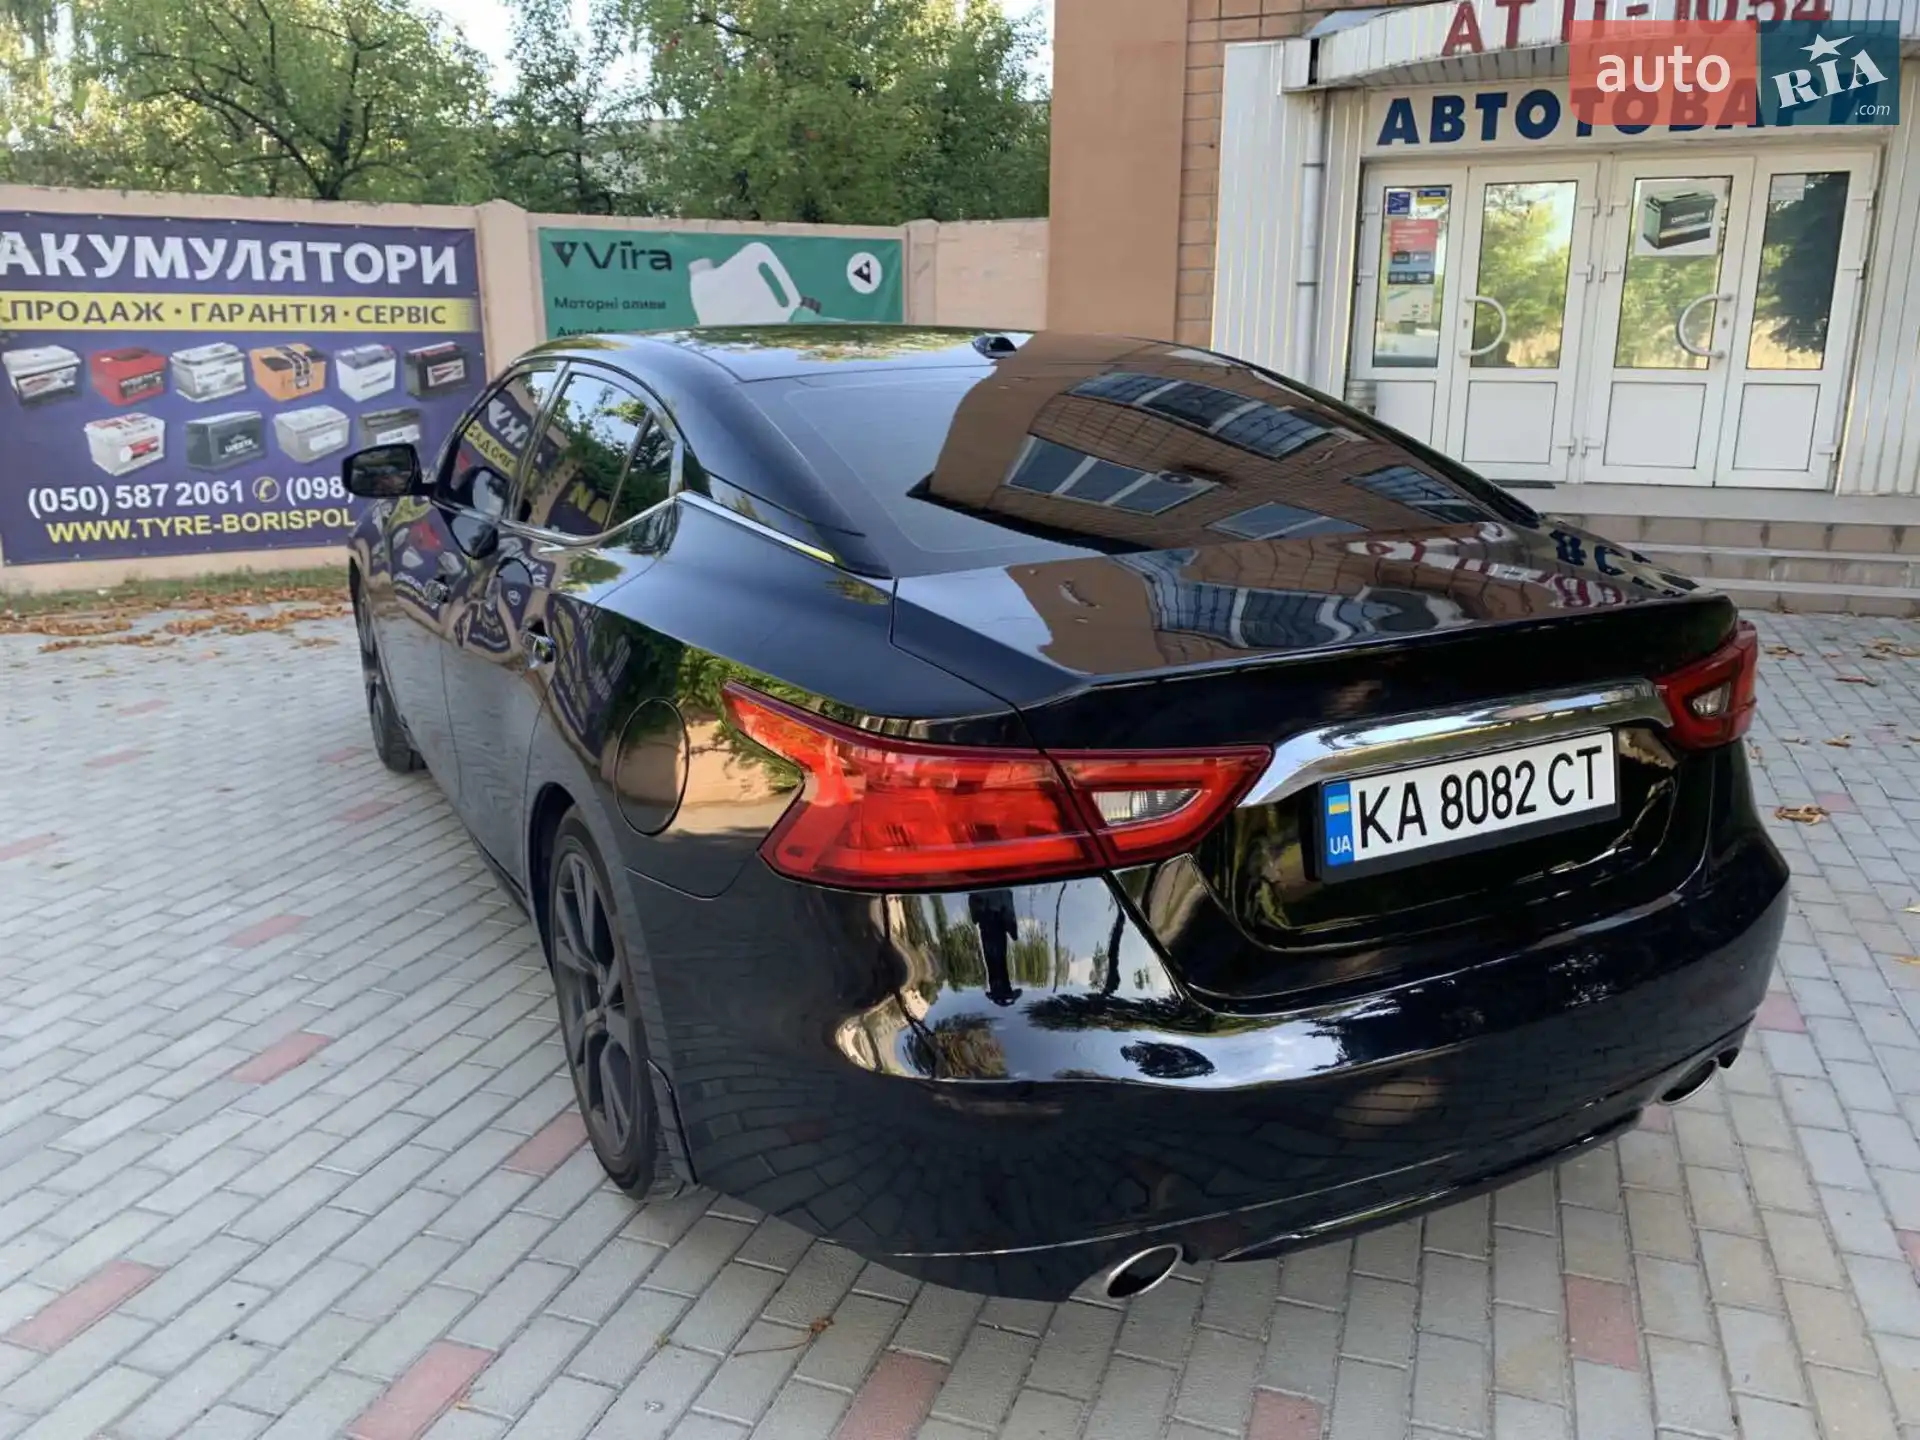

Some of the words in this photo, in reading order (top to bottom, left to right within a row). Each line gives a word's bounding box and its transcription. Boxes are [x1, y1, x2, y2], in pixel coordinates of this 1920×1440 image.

[0, 231, 458, 285] АКУМУЛЯТОРИ
[11, 299, 164, 324] ПРОДАЖ
[191, 302, 337, 323] ГАРАНТІЯ
[356, 305, 447, 324] СЕРВІС
[554, 297, 618, 312] Моторні
[28, 484, 110, 519] (050)
[115, 483, 170, 510] 587
[175, 480, 244, 507] 2061
[46, 508, 357, 544] WWW.TYRE-BORISPOL
[1358, 781, 1428, 848] KA
[1440, 759, 1537, 830] 8082
[1548, 744, 1603, 806] CT
[1330, 836, 1352, 855] UA
